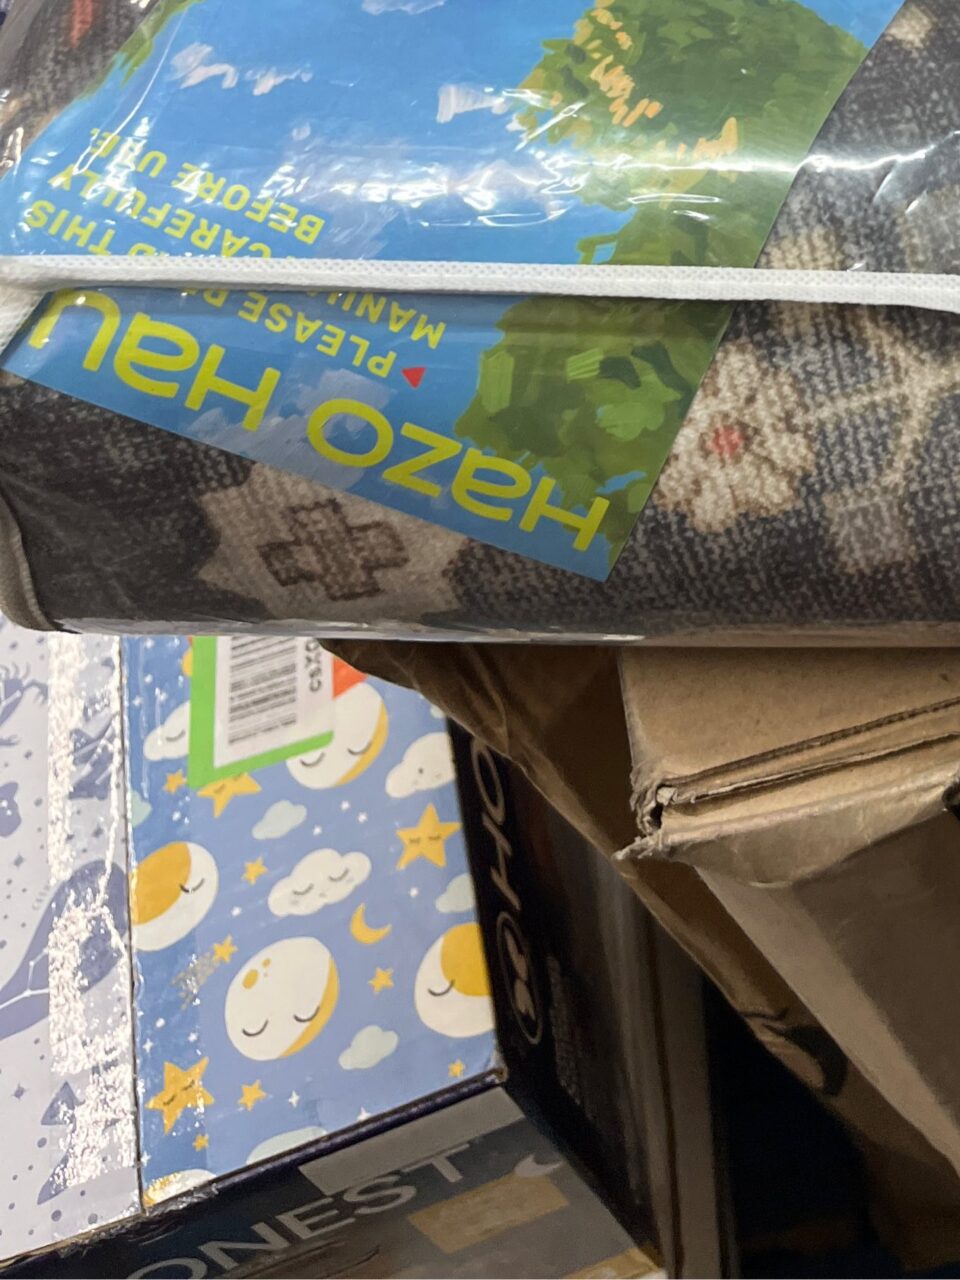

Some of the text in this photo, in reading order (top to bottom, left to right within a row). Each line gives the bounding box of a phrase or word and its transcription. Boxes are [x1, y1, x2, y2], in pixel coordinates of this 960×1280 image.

[24, 199, 116, 257] THIS
[171, 162, 325, 245] BEFORE
[237, 291, 397, 378] PLEASE
